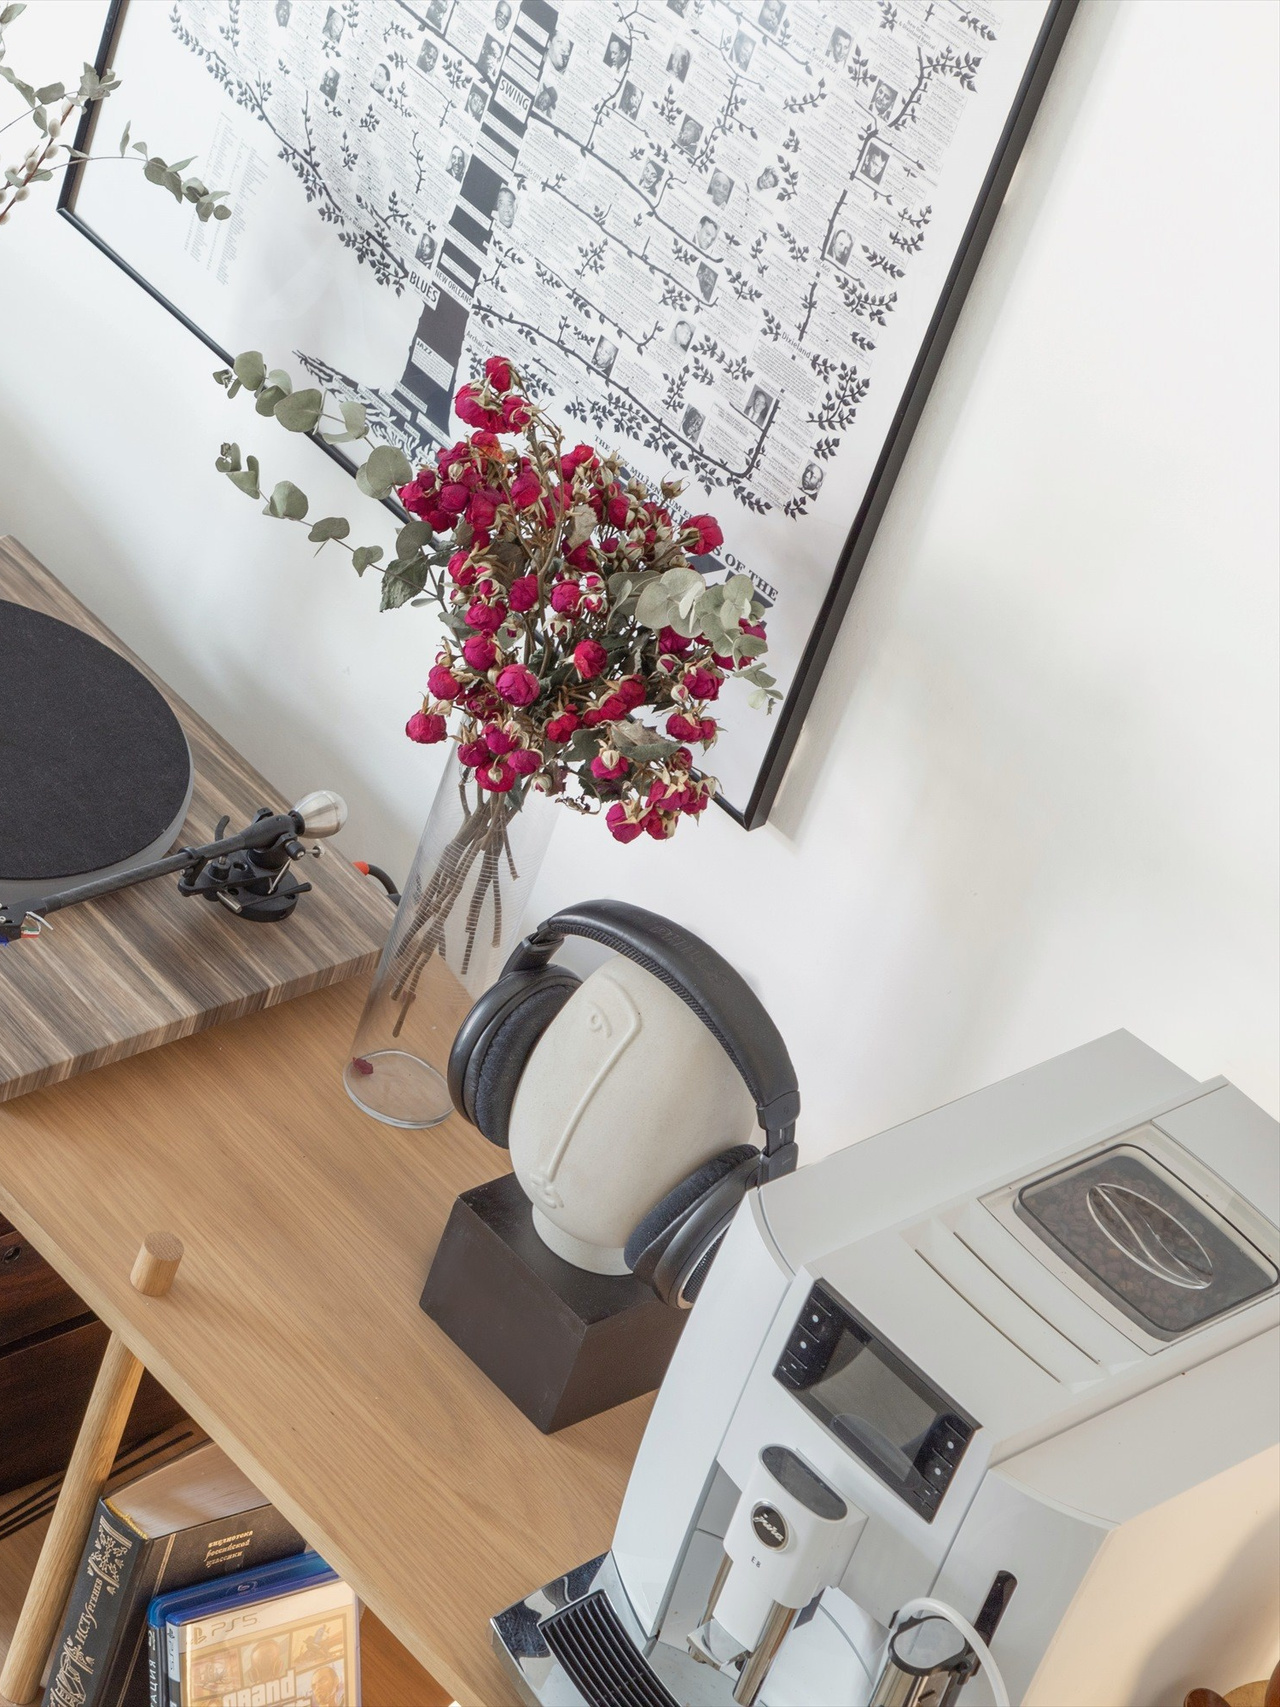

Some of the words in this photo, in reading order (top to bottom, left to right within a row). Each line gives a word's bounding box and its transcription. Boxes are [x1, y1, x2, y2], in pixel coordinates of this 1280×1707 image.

[499, 78, 529, 111] SWING
[408, 270, 439, 303] BLUES
[433, 268, 447, 285] NEW
[446, 279, 473, 306] ORLEANS
[415, 338, 432, 356] JAZZ
[782, 331, 810, 359] Dixieland
[725, 553, 745, 573] OF
[749, 570, 779, 602] THE
[753, 1513, 784, 1542] jura
[212, 1613, 258, 1637] PS5
